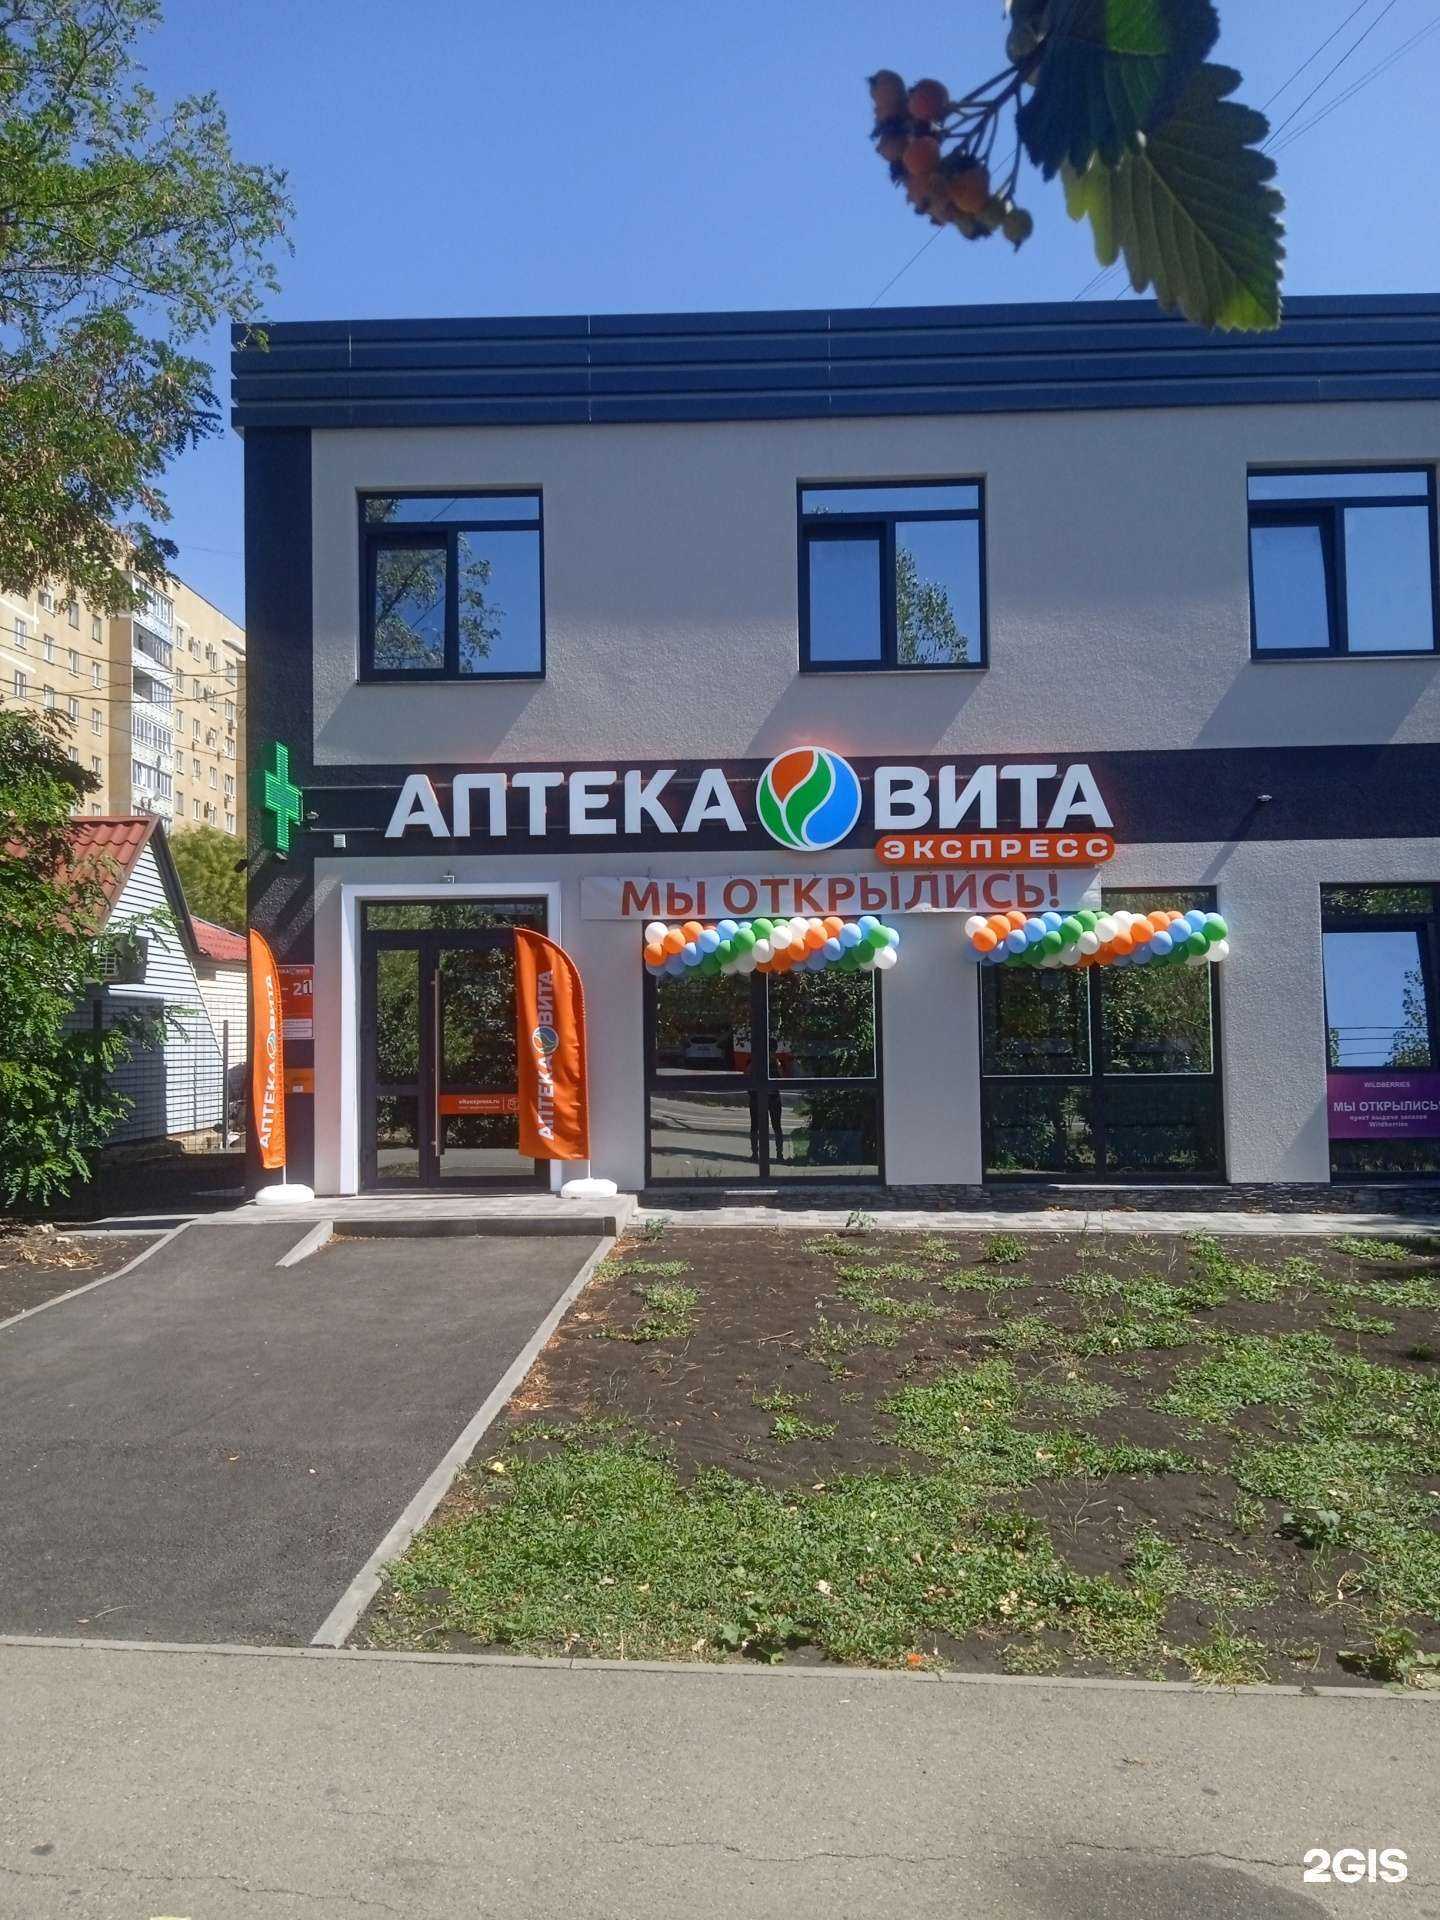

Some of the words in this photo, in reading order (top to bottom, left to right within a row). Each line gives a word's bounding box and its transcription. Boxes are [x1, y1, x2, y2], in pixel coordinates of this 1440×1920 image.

[385, 768, 748, 838] АПТЕКА
[874, 763, 1114, 831] ВИТА
[883, 838, 1109, 860] ЭКСПРЕСС
[621, 880, 707, 916] МЫ
[722, 873, 1060, 915] ОТКРЫЛИСЬ!
[537, 968, 554, 1026] ВИТА
[259, 1059, 277, 1149] АПТЕКА
[537, 1054, 555, 1141] АПТЕКА
[1333, 1101, 1356, 1112] МЫ
